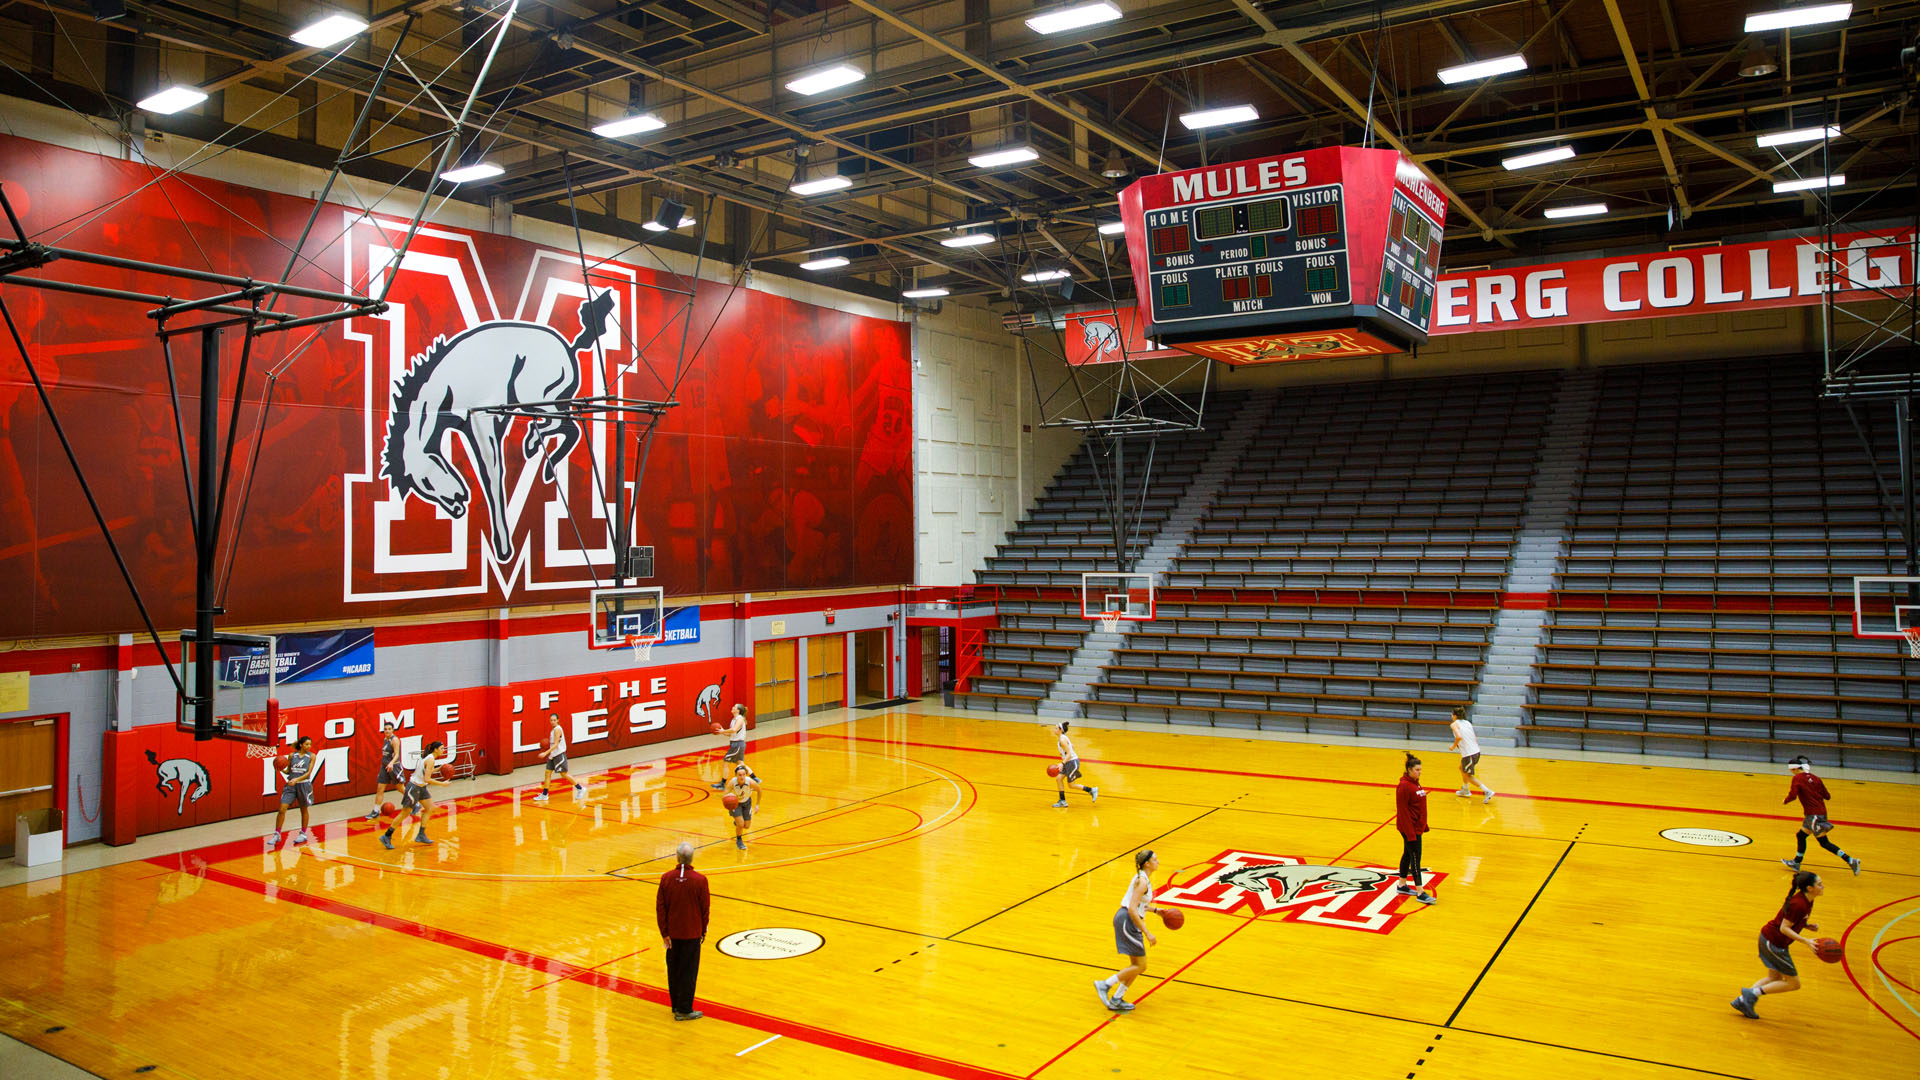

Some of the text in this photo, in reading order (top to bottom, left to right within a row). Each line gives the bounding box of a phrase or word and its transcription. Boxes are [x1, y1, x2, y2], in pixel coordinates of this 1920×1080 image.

[1172, 157, 1308, 203] MULES
[1292, 189, 1339, 207] VISITOR
[1150, 210, 1189, 227] HOME
[1295, 238, 1327, 251] BONUS
[1166, 254, 1195, 267] BONUS
[1220, 248, 1248, 260] PERIOD
[1306, 255, 1336, 268] FOULS
[1215, 261, 1284, 279] PLAYER FOULS
[1603, 233, 1920, 312] COLLEG
[1161, 272, 1188, 285] FOULS
[1311, 292, 1332, 304] WON
[1233, 299, 1263, 312] MATCH
[664, 628, 697, 641] SKETBALL
[250, 657, 297, 669] BASKTBALL
[248, 666, 290, 676] CHAMPISHIP
[277, 703, 460, 746] HOME
[588, 677, 668, 704] THE
